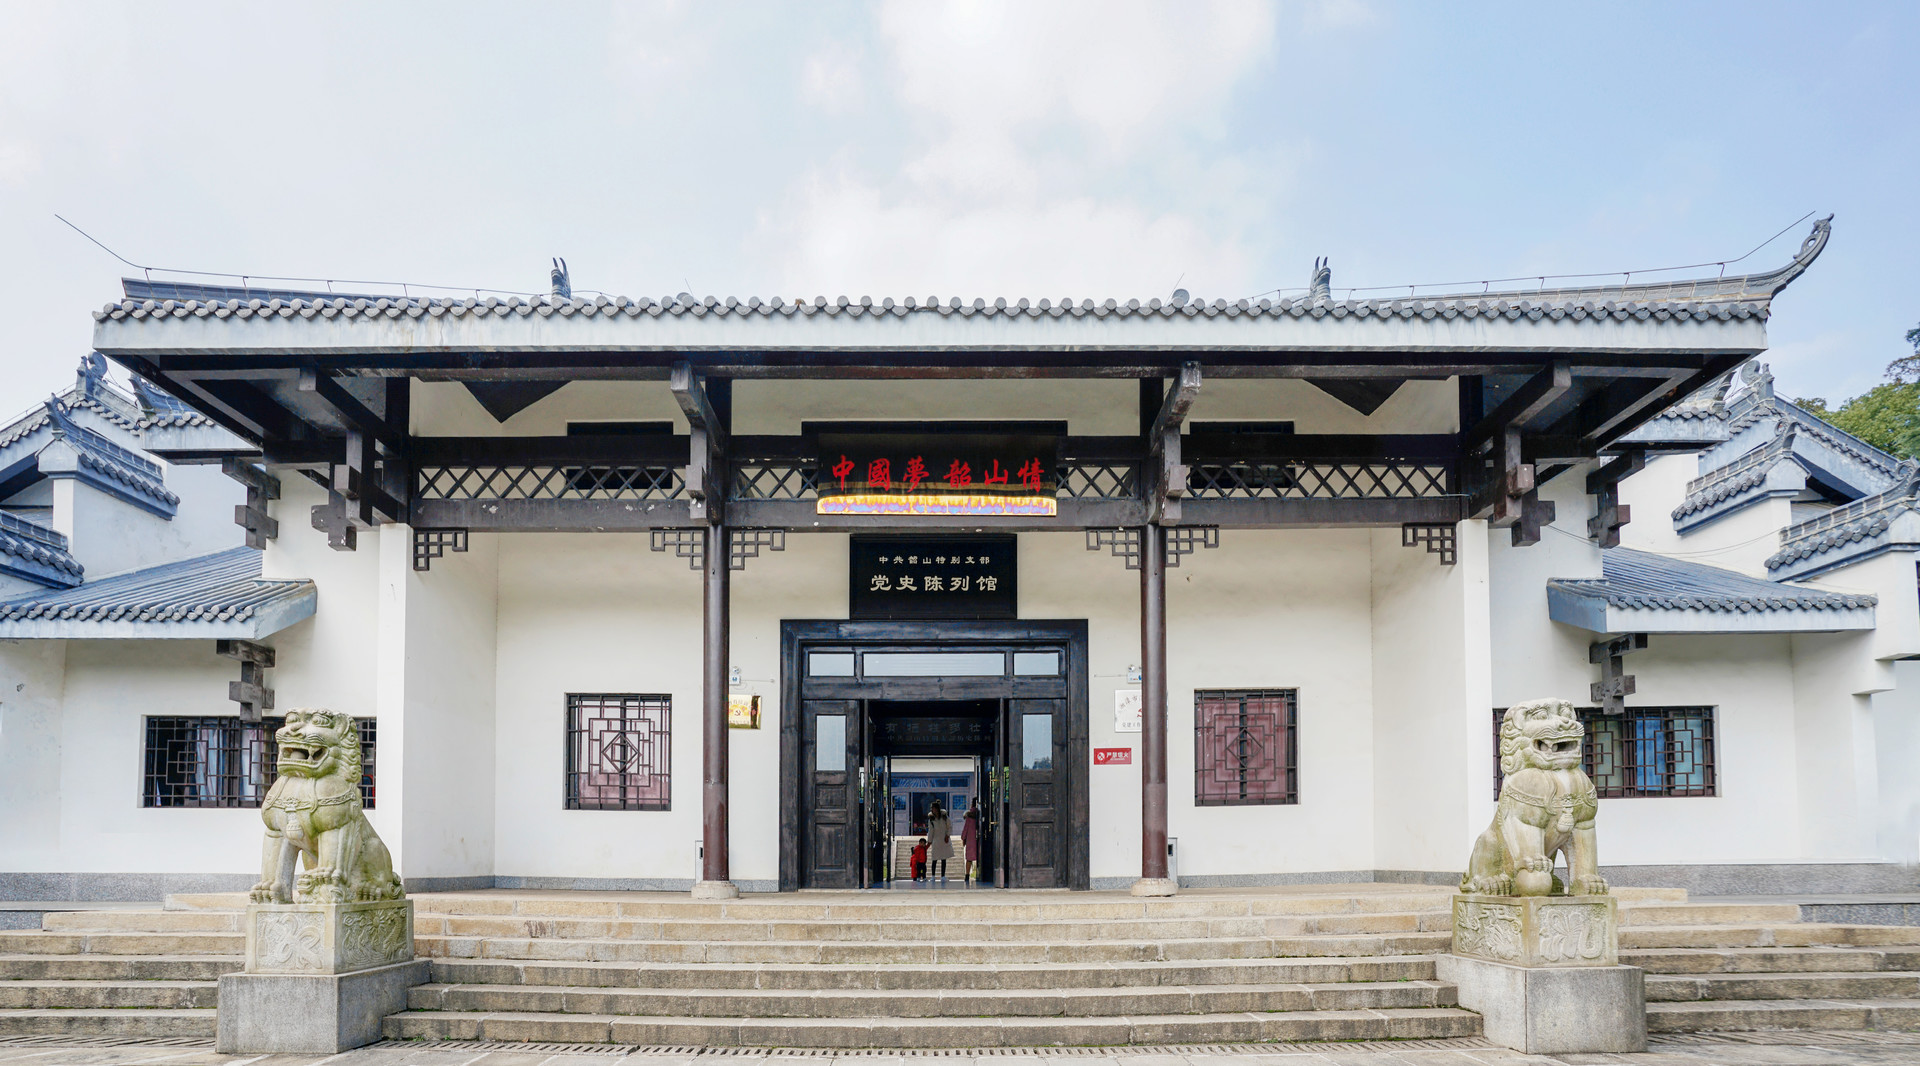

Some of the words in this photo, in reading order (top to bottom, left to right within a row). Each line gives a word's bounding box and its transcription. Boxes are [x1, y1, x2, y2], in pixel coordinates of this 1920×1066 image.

[878, 555, 991, 565] 中共韶山特别支部
[869, 574, 998, 592] 党史陈列馆
